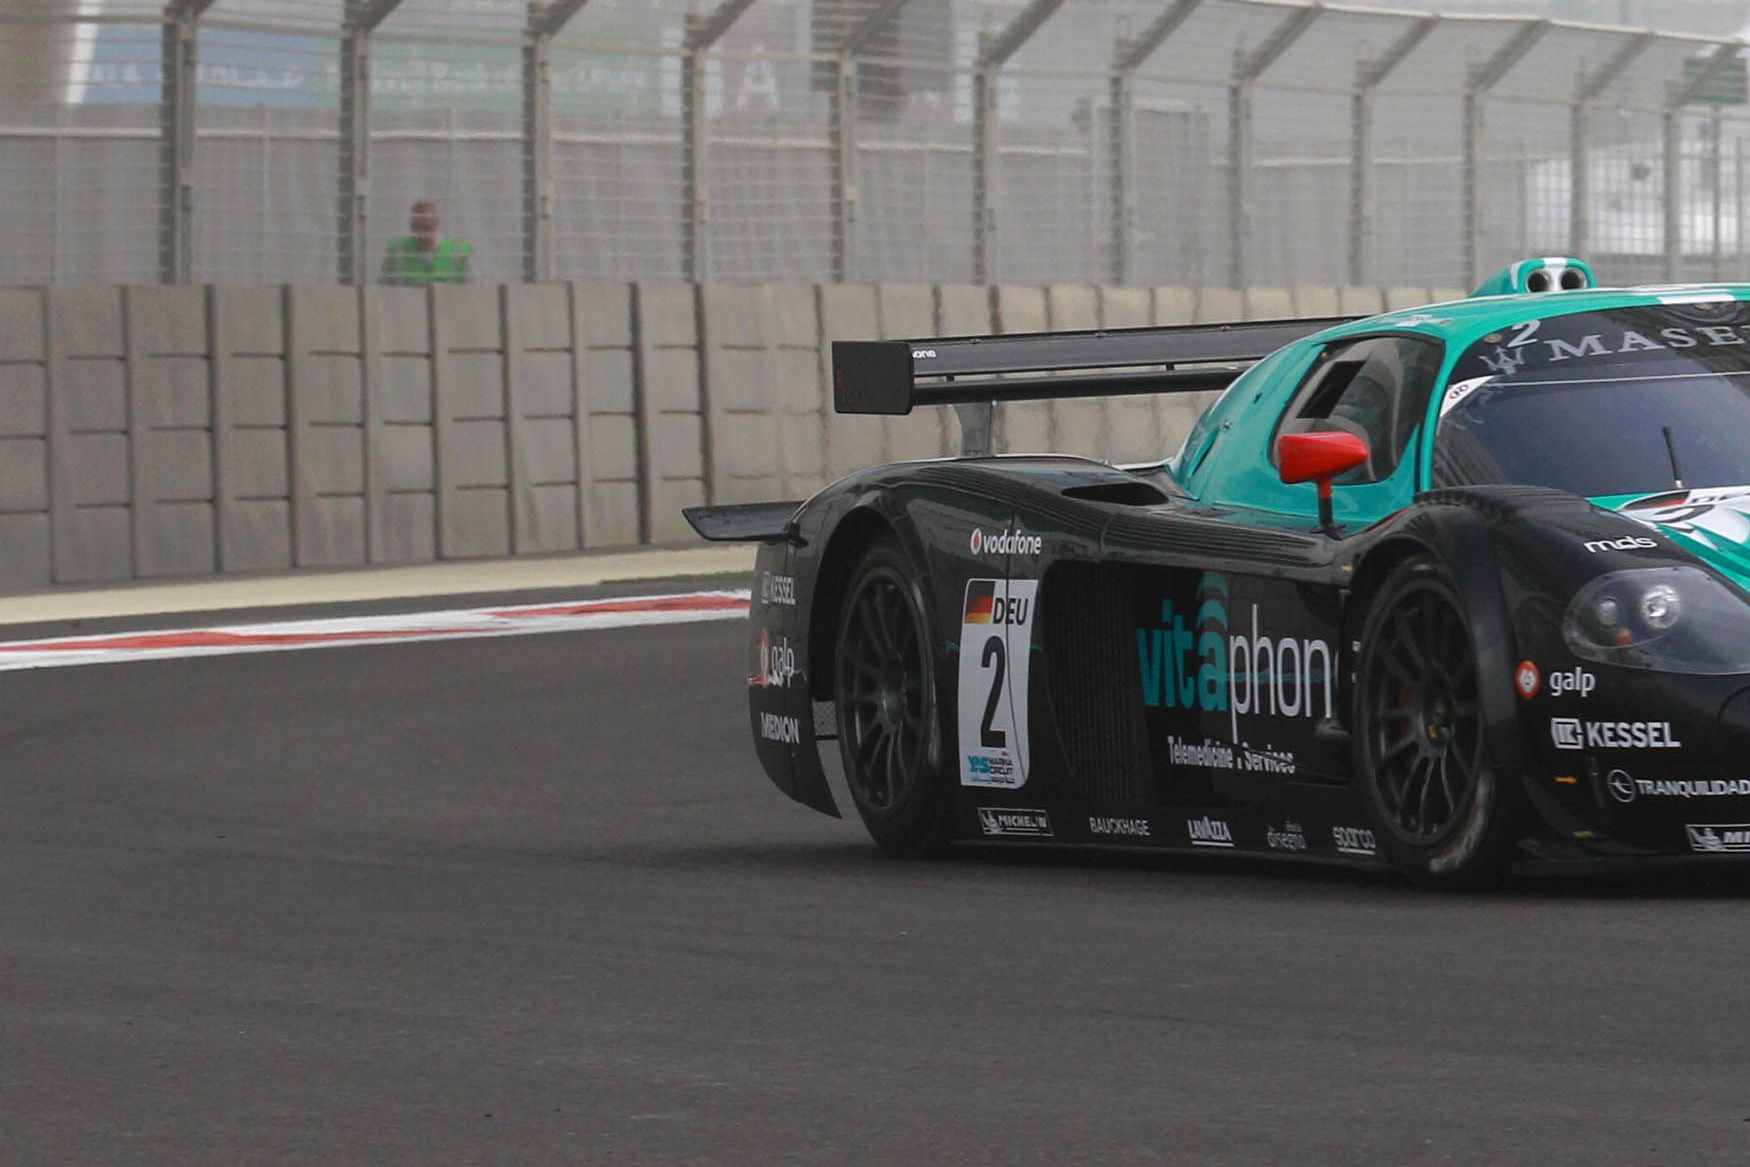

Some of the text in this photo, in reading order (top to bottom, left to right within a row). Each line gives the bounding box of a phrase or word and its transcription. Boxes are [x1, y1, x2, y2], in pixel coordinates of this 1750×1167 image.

[1507, 318, 1542, 348] 2
[983, 530, 1042, 555] vodafone
[1583, 536, 1659, 554] mds
[993, 597, 1029, 626] DEU
[1135, 598, 1340, 744] vitaphon
[1549, 666, 1596, 697] galp
[981, 635, 1007, 748] 2
[760, 712, 801, 744] MEDION
[1586, 721, 1682, 749] KESSEL
[1088, 817, 1151, 836] BAUCKHAGE
